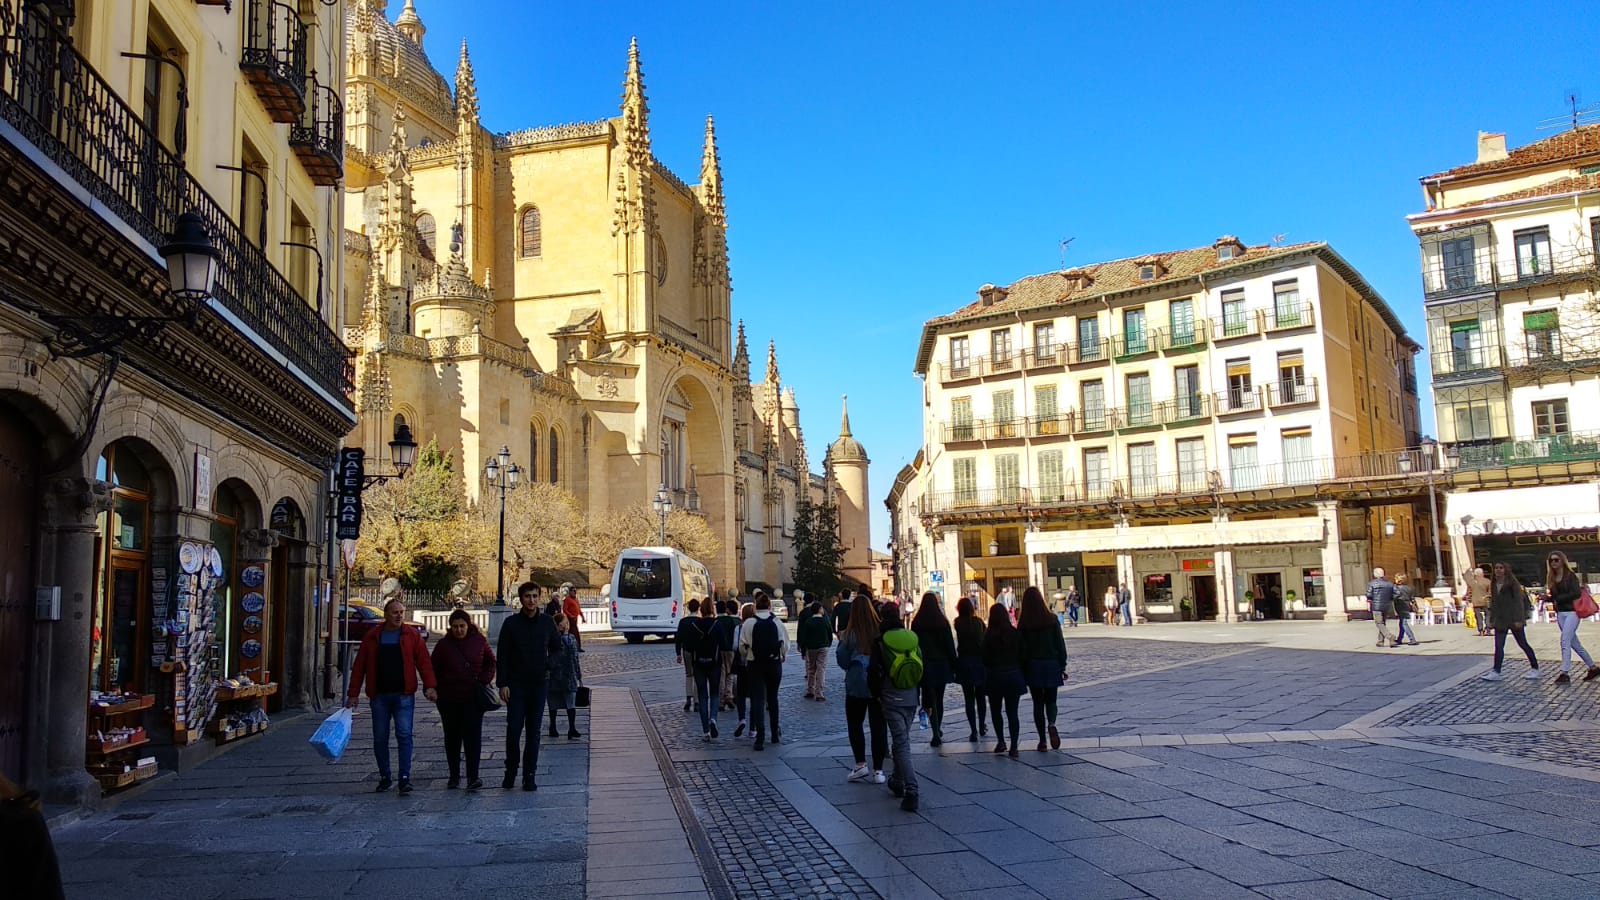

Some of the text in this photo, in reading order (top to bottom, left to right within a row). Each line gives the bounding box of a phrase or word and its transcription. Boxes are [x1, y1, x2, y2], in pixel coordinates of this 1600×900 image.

[344, 451, 359, 486] CAFE
[341, 496, 357, 522] BAR
[1453, 516, 1572, 535] RESTAURANTE
[1537, 535, 1552, 543] LA
